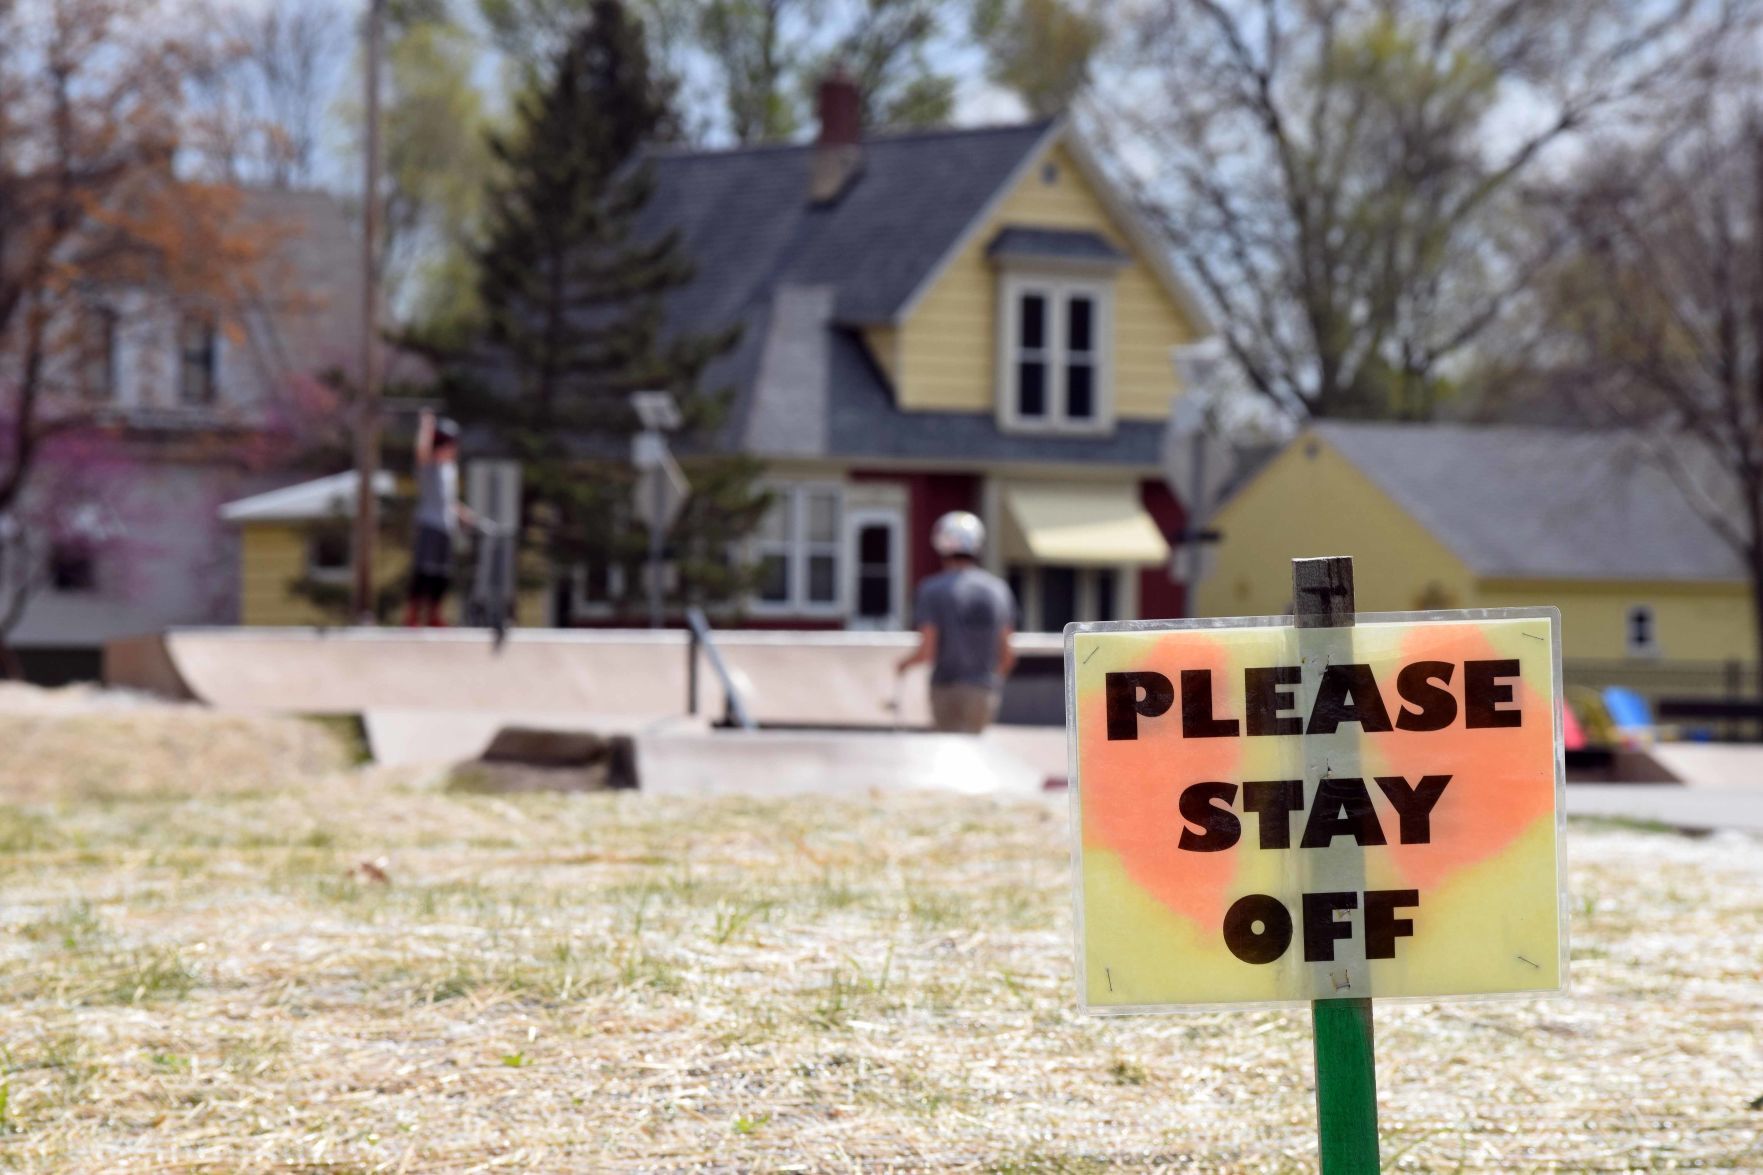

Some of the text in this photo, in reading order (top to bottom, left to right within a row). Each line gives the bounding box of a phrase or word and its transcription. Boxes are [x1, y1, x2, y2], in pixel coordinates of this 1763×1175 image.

[1105, 659, 1522, 741] PLEASE
[1178, 775, 1452, 852] STAY
[1223, 889, 1420, 965] OFF
